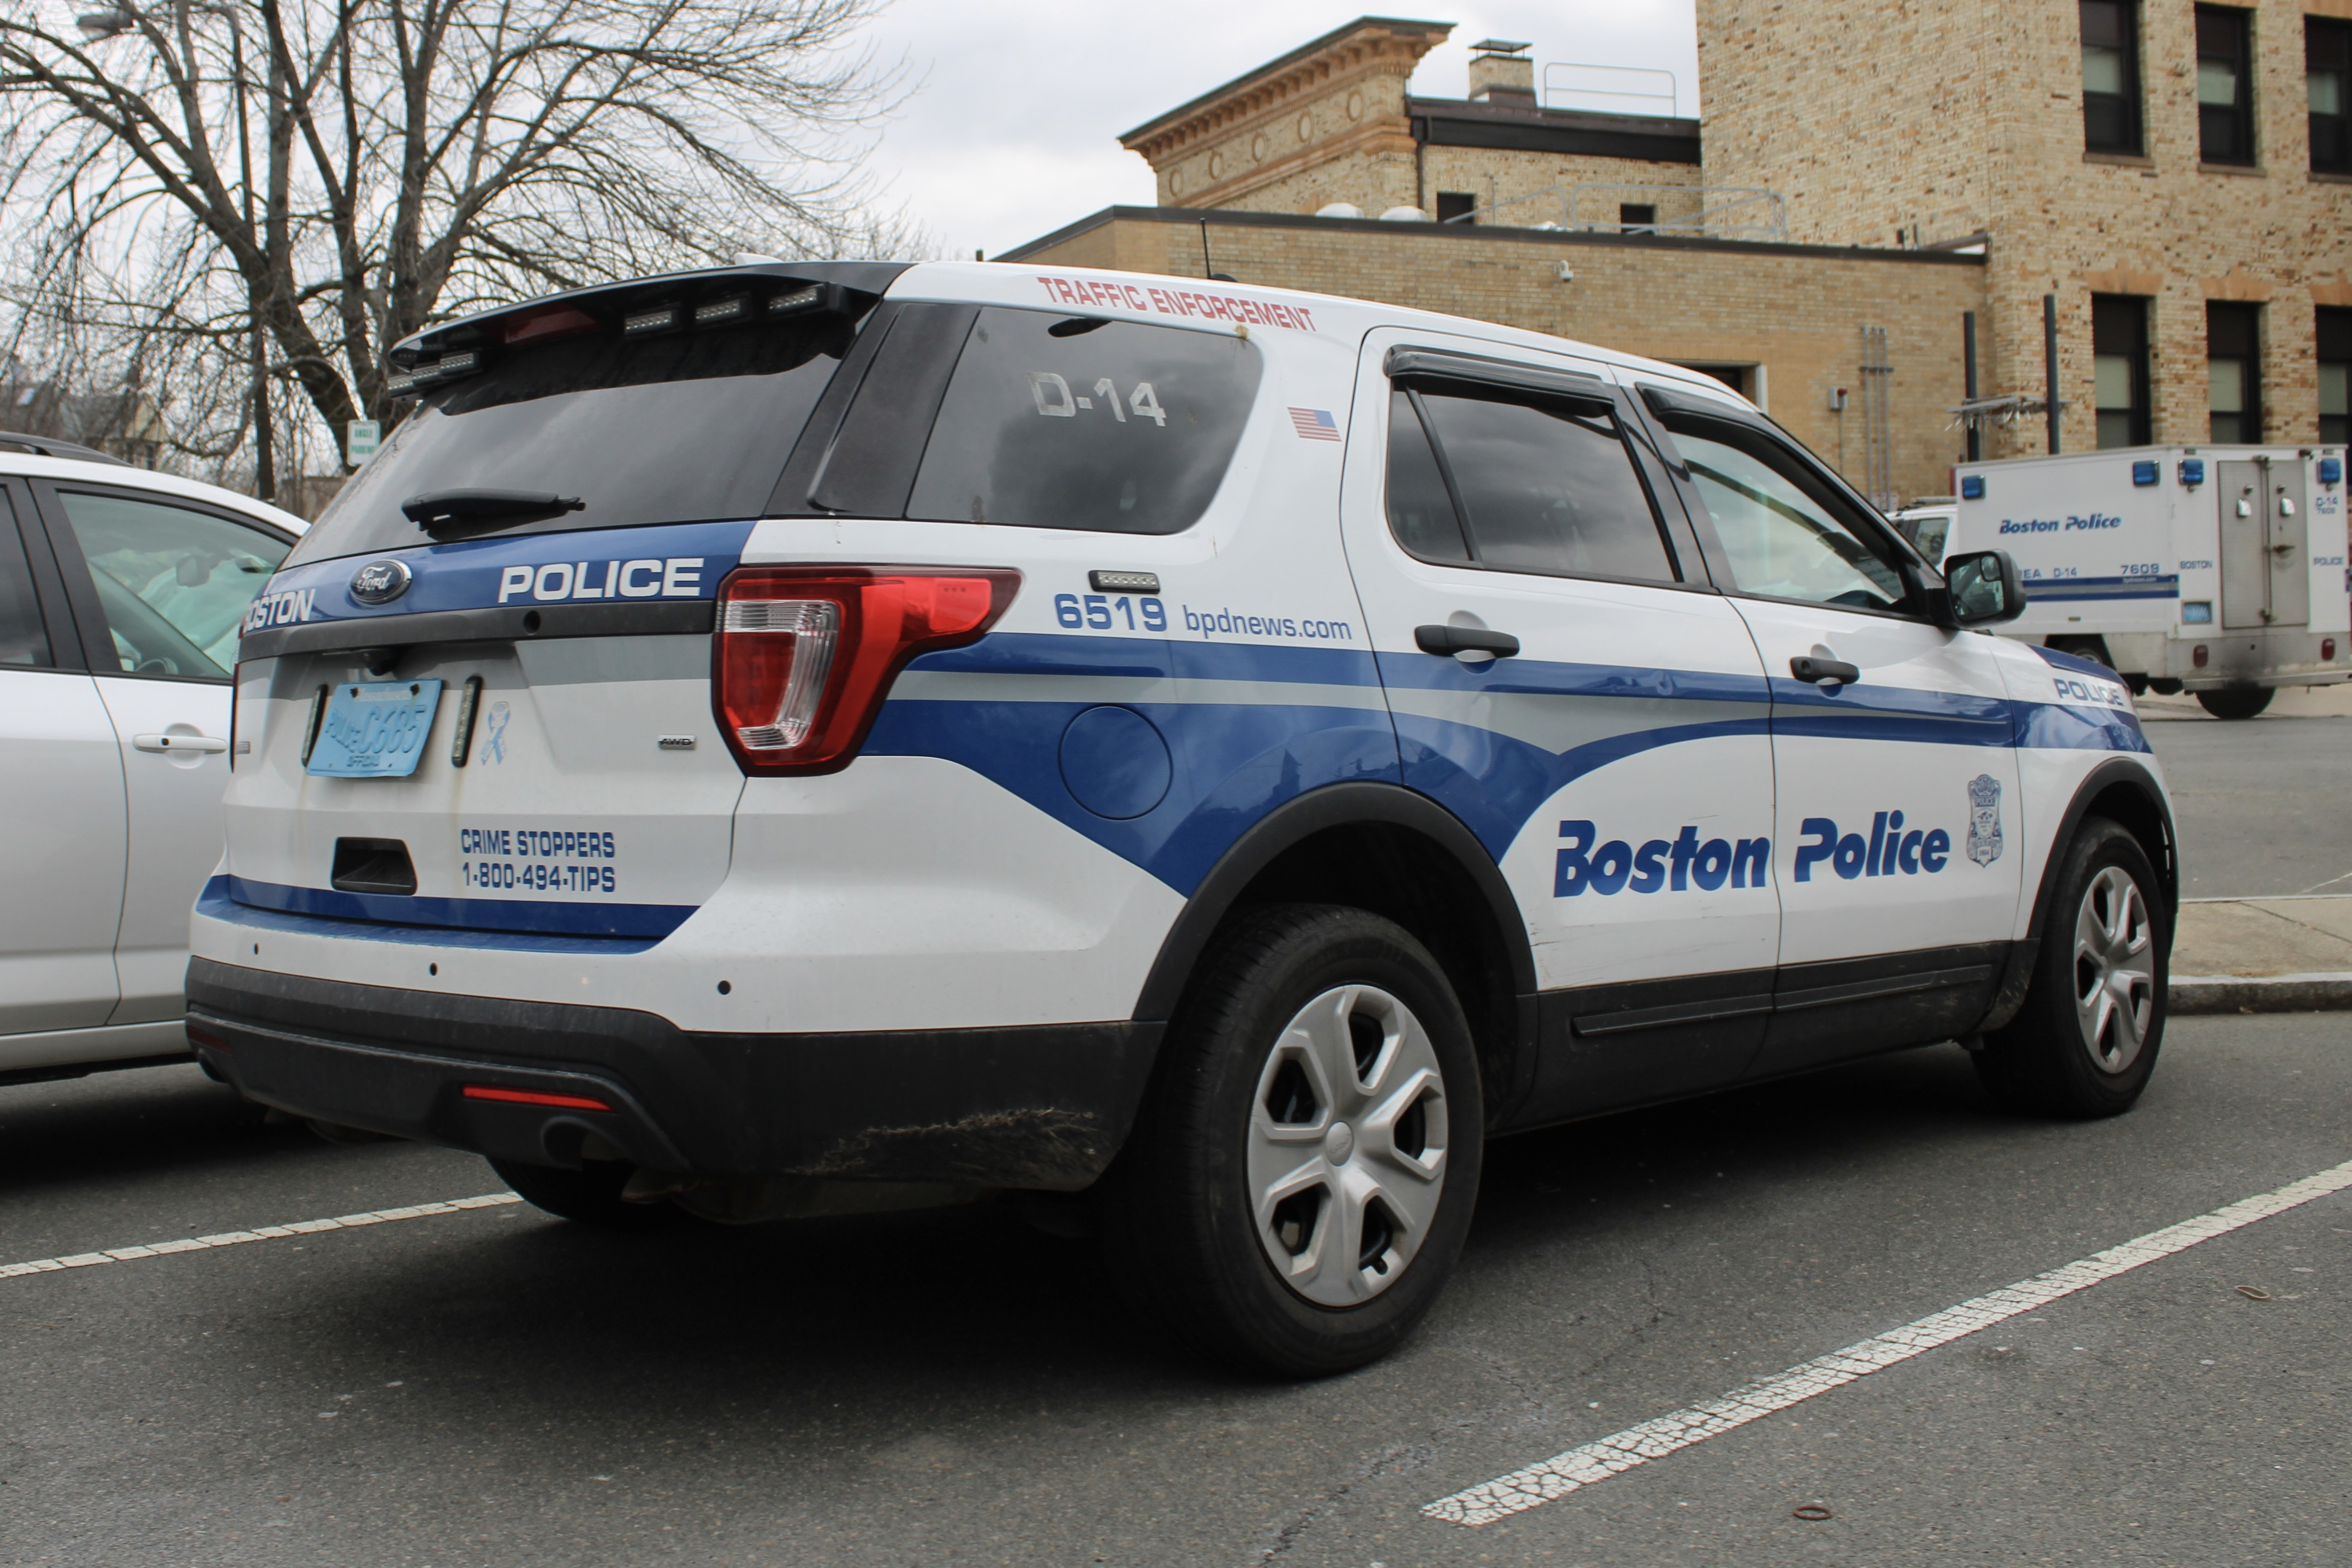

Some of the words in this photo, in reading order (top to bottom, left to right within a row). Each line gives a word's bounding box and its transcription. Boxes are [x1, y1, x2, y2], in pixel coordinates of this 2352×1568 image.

[1038, 277, 1148, 311] TRAFFIC
[1147, 287, 1316, 332] ENFORCEMENT
[1028, 372, 1167, 427] D-14
[2000, 519, 2060, 534] Boston
[2065, 513, 2122, 530] Police
[2054, 567, 2078, 578] D-14
[2121, 563, 2160, 575] 7609
[2180, 560, 2213, 569] BOSTON
[2314, 557, 2344, 565] POLICE
[357, 566, 392, 590] Ford
[498, 558, 704, 604] POLICE
[1054, 593, 1167, 632] 6519
[1183, 605, 1352, 640] bpdnews.com
[2053, 678, 2124, 706] POLICE
[461, 829, 511, 855] CRIME
[517, 830, 615, 858] STOPPERS
[1553, 819, 1771, 899] Boston
[1793, 809, 1951, 884] Police
[462, 861, 615, 892] 1-800-494-TIPS
